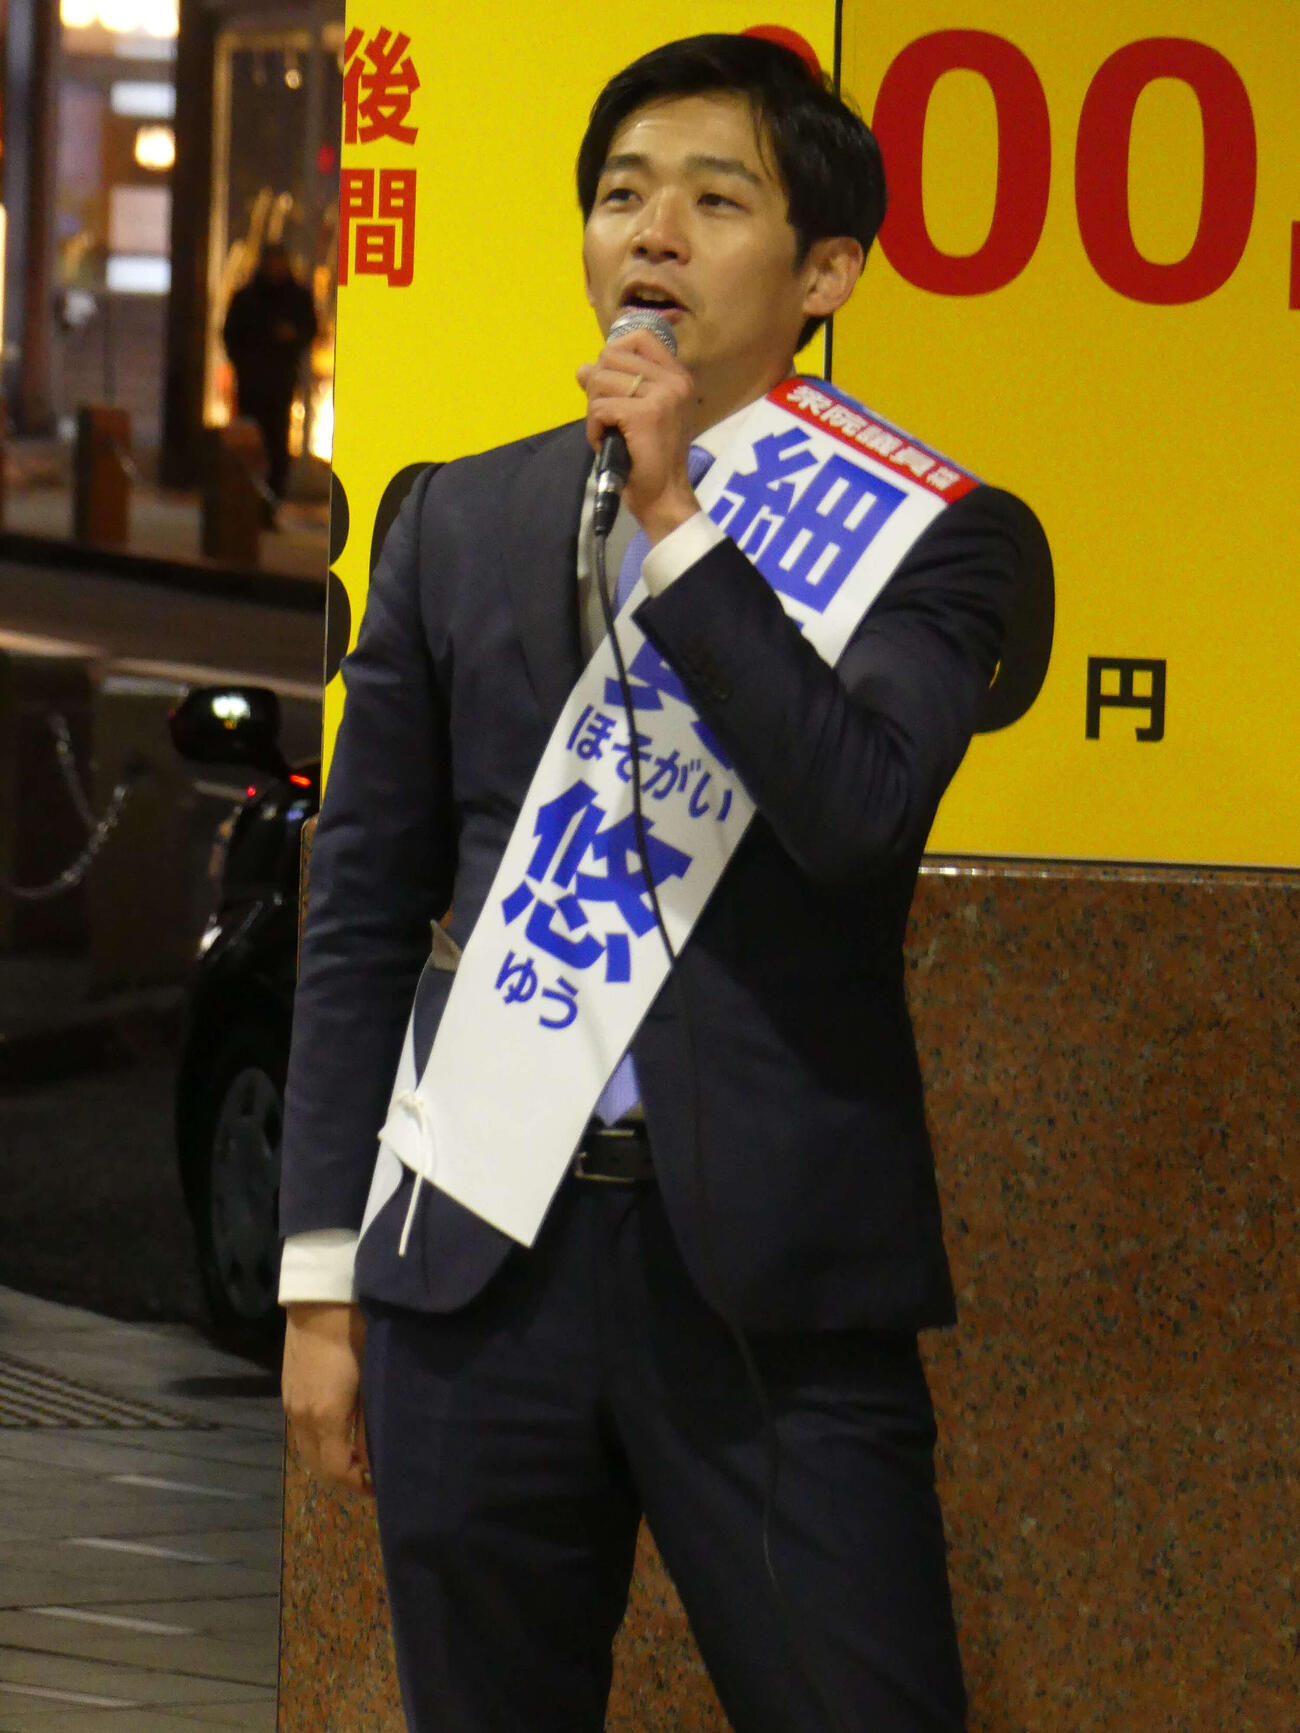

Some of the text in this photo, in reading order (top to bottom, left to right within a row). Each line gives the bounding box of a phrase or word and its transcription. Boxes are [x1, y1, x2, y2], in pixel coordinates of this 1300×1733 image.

[343, 26, 421, 146] 後
[338, 168, 417, 288] 間
[1085, 655, 1167, 743] 円
[567, 704, 732, 822] ほそがい
[501, 779, 693, 983] 悠
[495, 950, 579, 1030] ゆう
